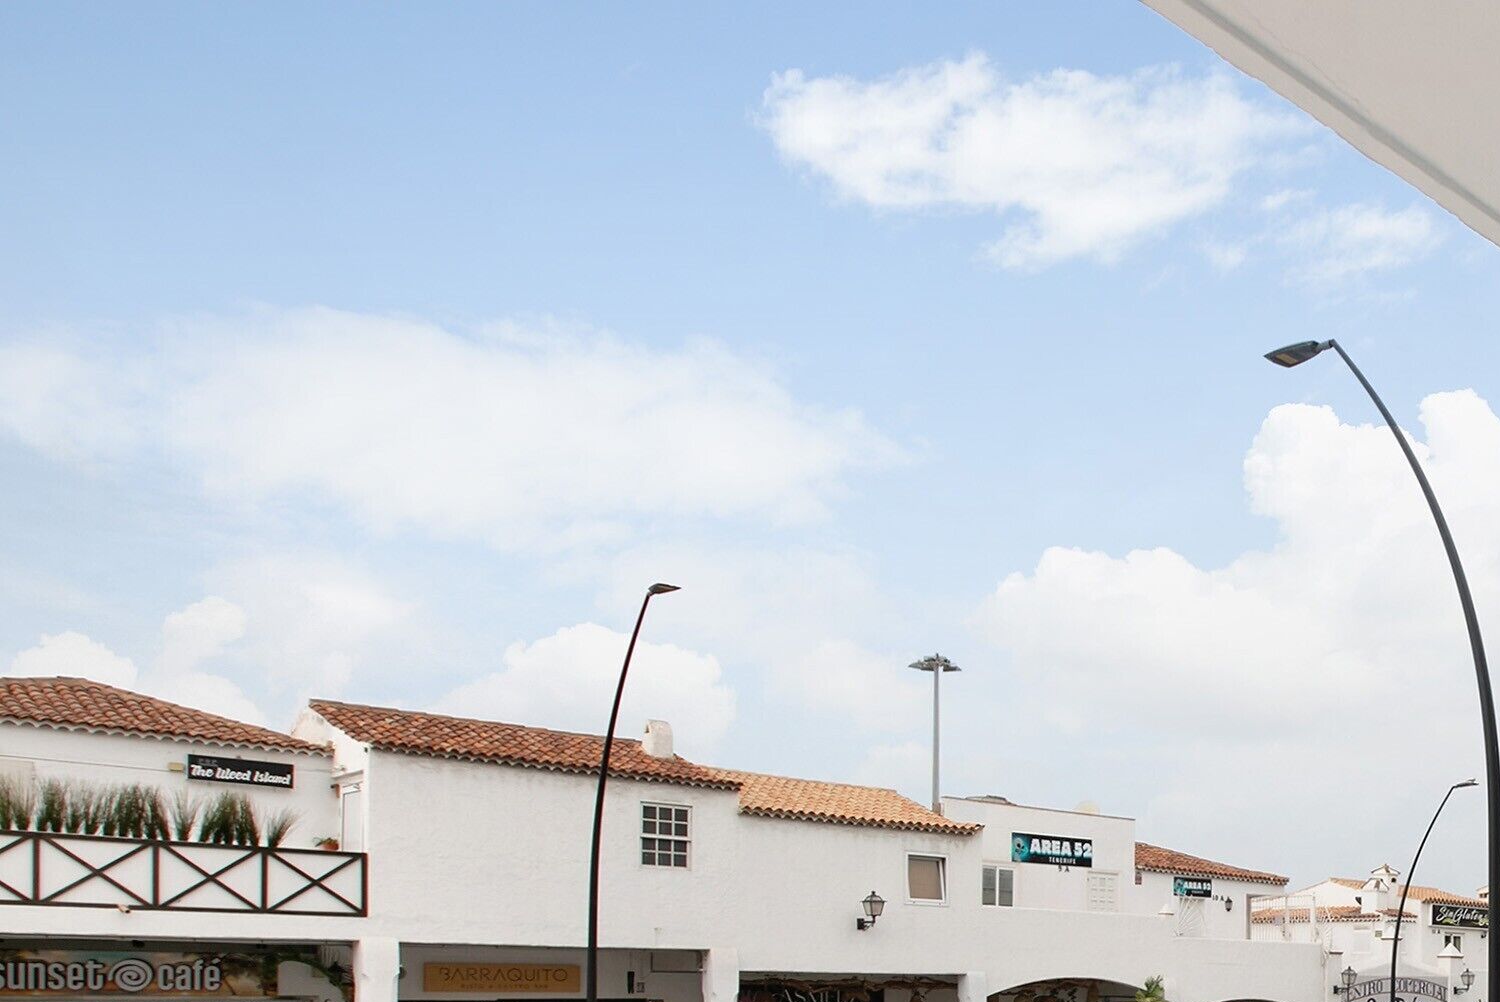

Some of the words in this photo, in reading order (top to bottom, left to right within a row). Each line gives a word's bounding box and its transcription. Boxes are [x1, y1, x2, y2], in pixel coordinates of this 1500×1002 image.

[190, 764, 214, 778] The
[253, 771, 292, 785] Island
[1030, 838, 1072, 856] AREA
[1073, 842, 1093, 858] 52
[157, 957, 222, 991] café
[439, 967, 568, 982] BARRAQUITO
